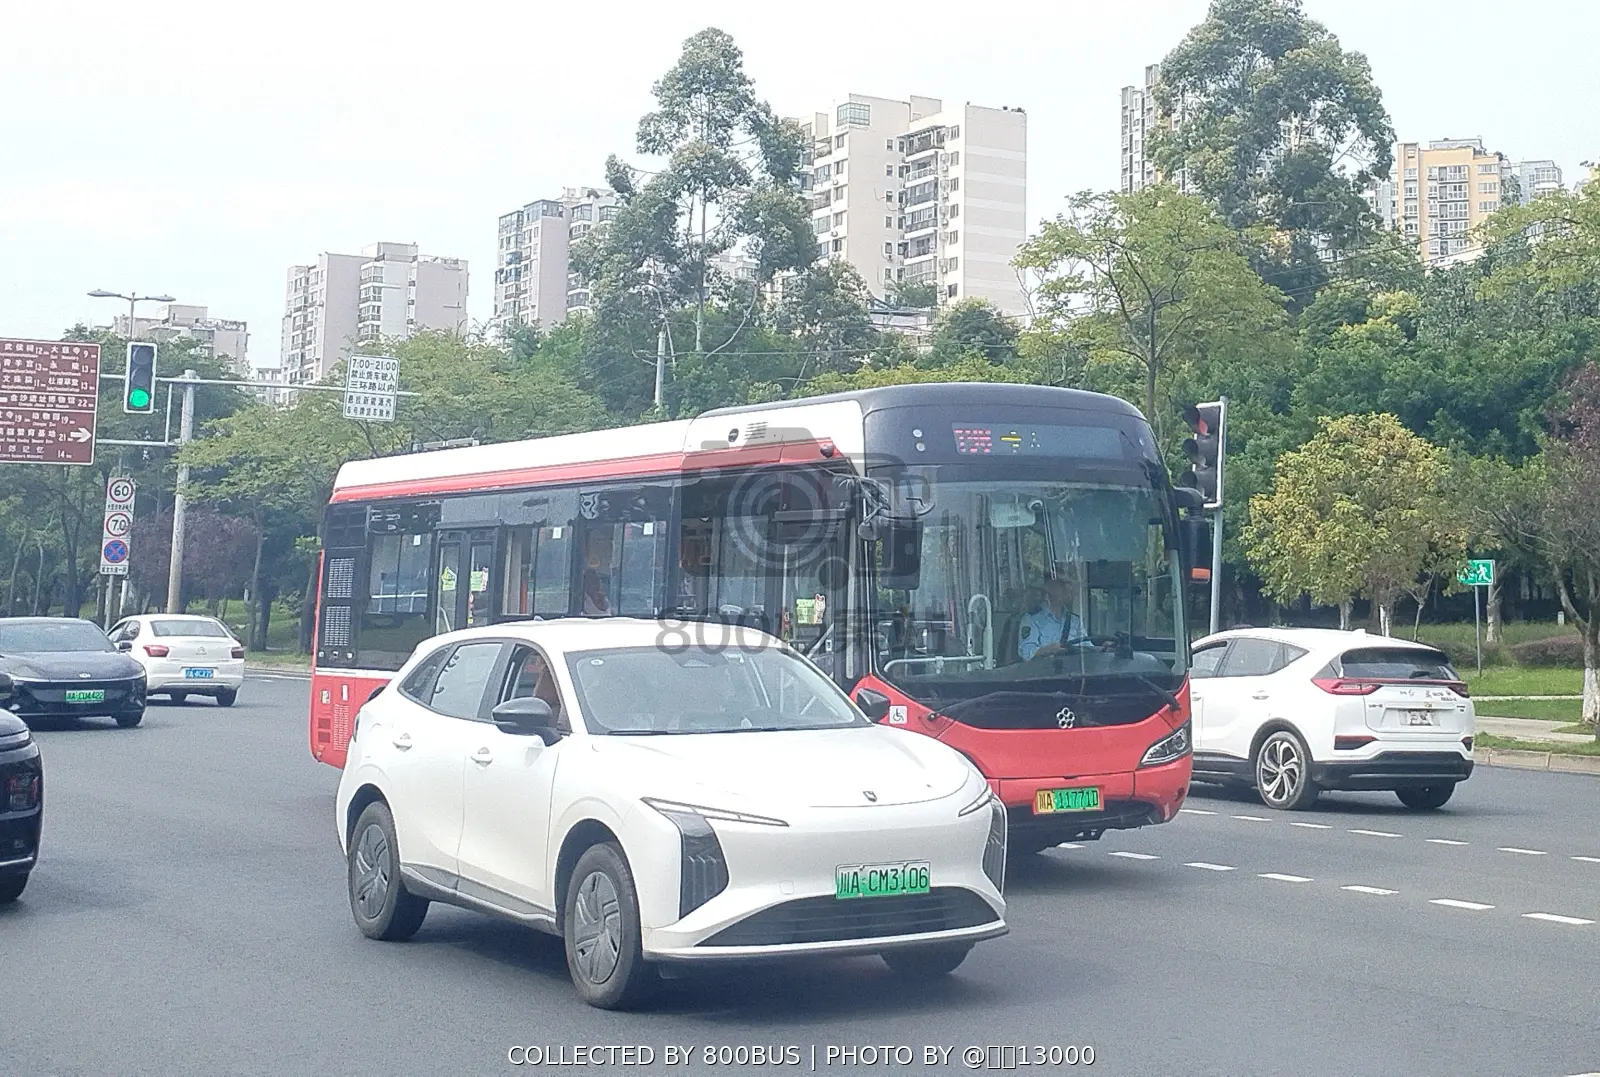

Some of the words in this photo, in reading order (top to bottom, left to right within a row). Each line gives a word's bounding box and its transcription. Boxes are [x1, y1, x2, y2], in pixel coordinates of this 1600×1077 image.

[349, 381, 395, 392] 三环路以内
[113, 485, 130, 497] 60
[111, 519, 127, 531] 70
